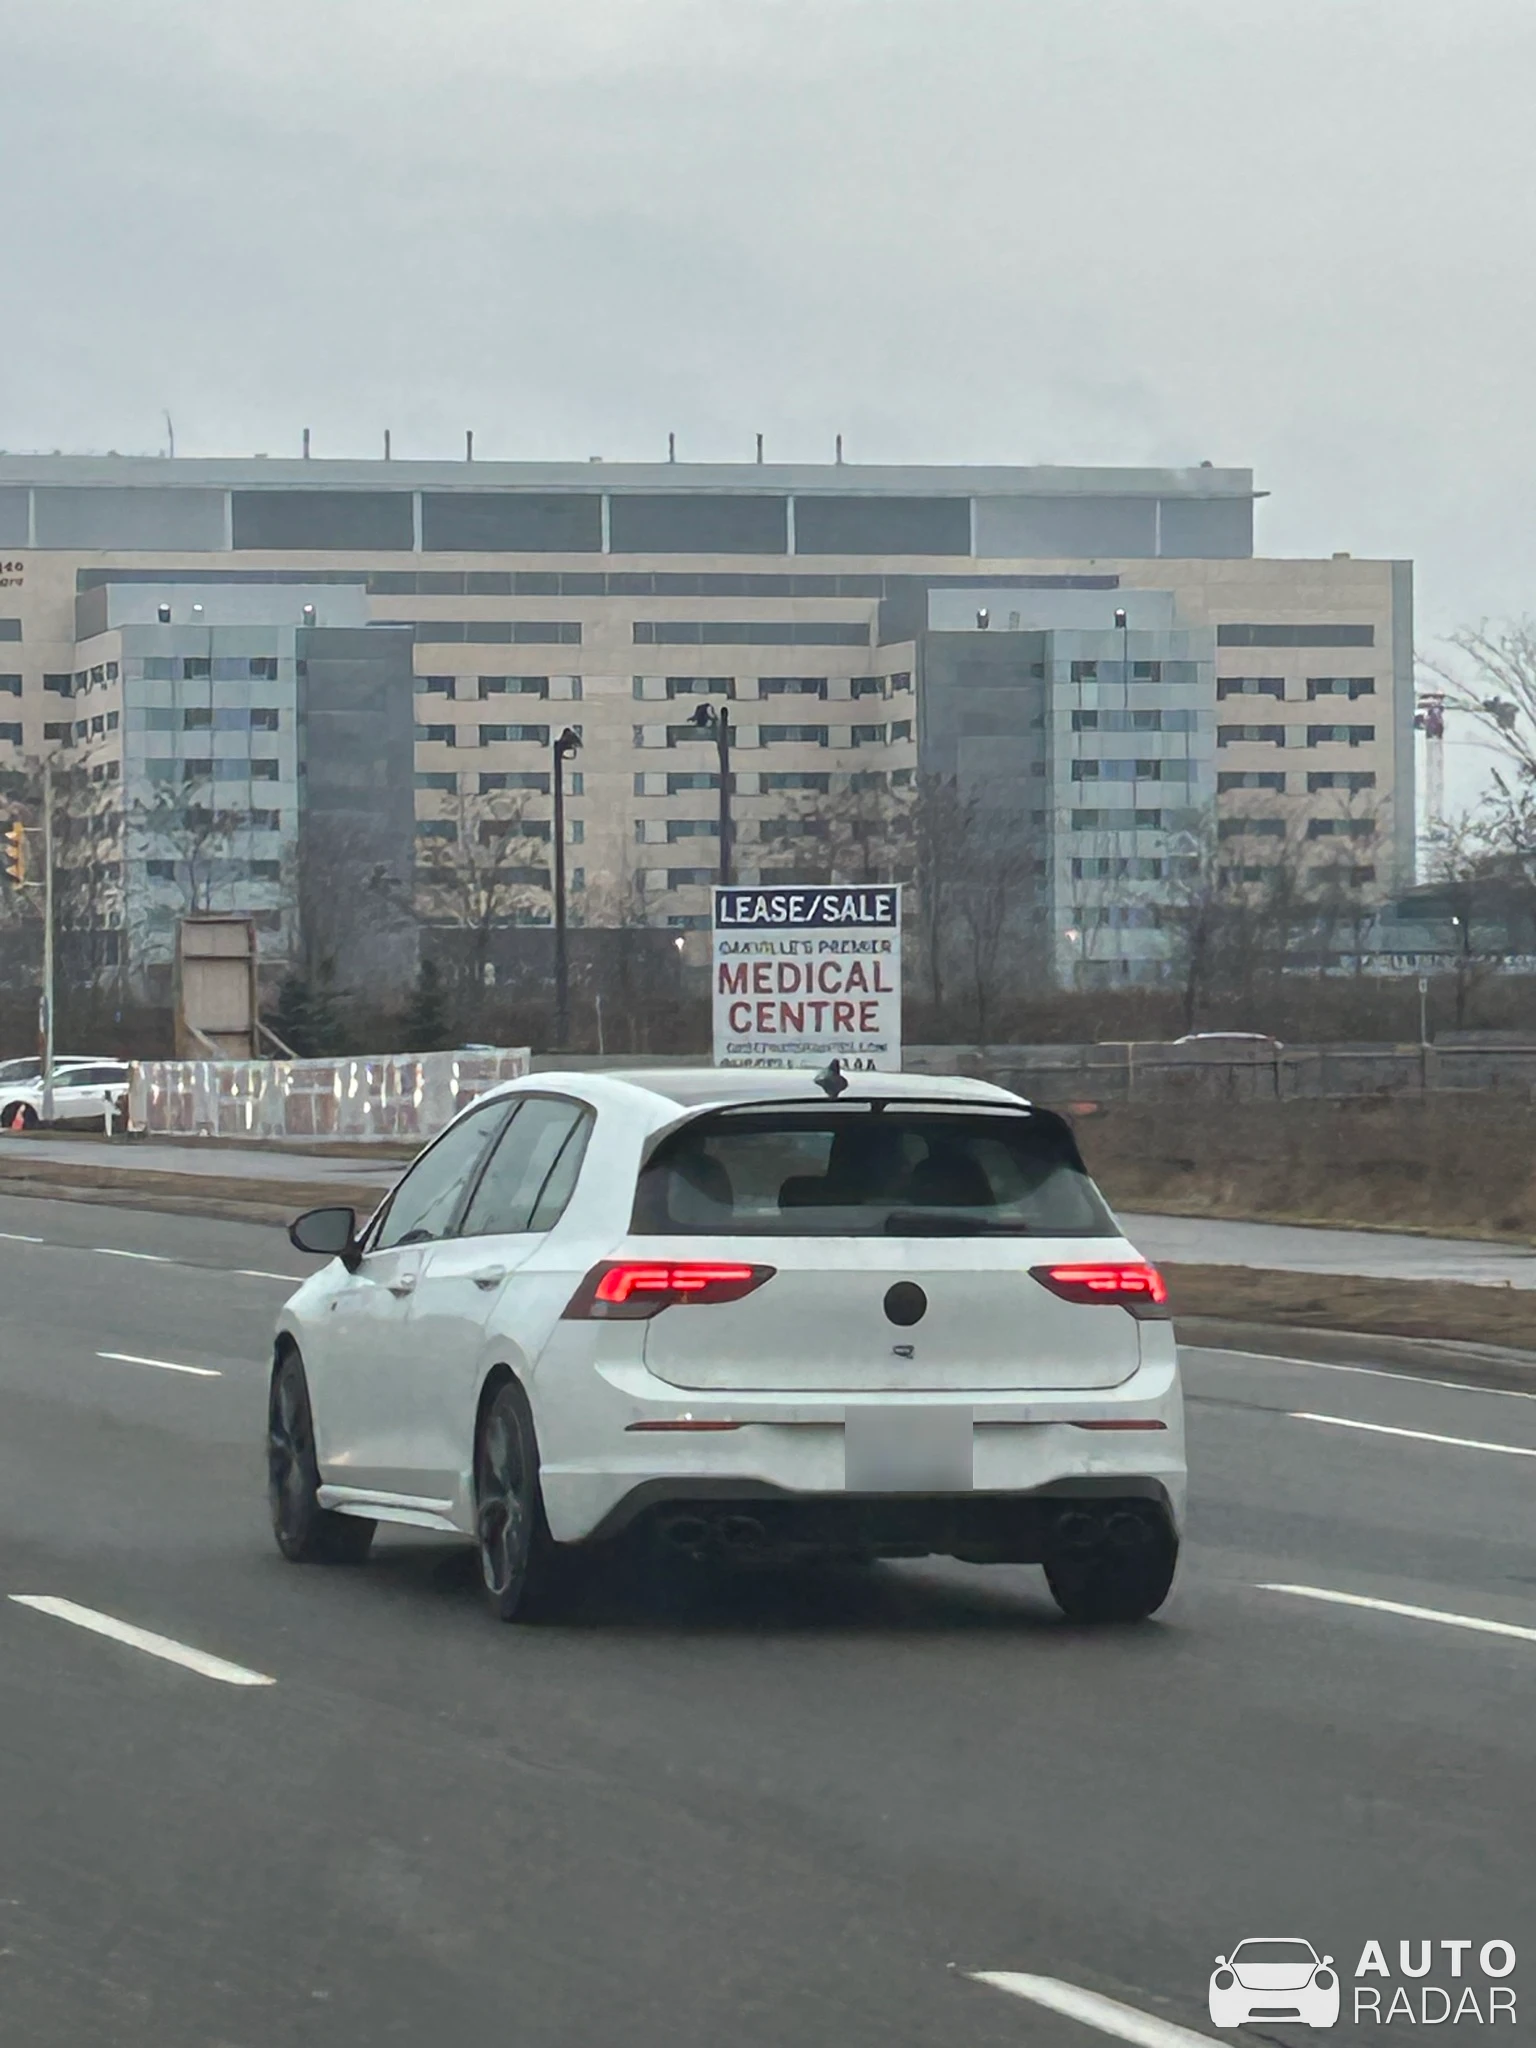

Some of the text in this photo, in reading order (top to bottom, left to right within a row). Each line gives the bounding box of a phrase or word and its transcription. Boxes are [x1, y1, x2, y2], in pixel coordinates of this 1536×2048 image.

[720, 894, 892, 923] LEASE/SALE
[718, 960, 893, 994] MEDICAL
[728, 1001, 880, 1033] CENTRE
